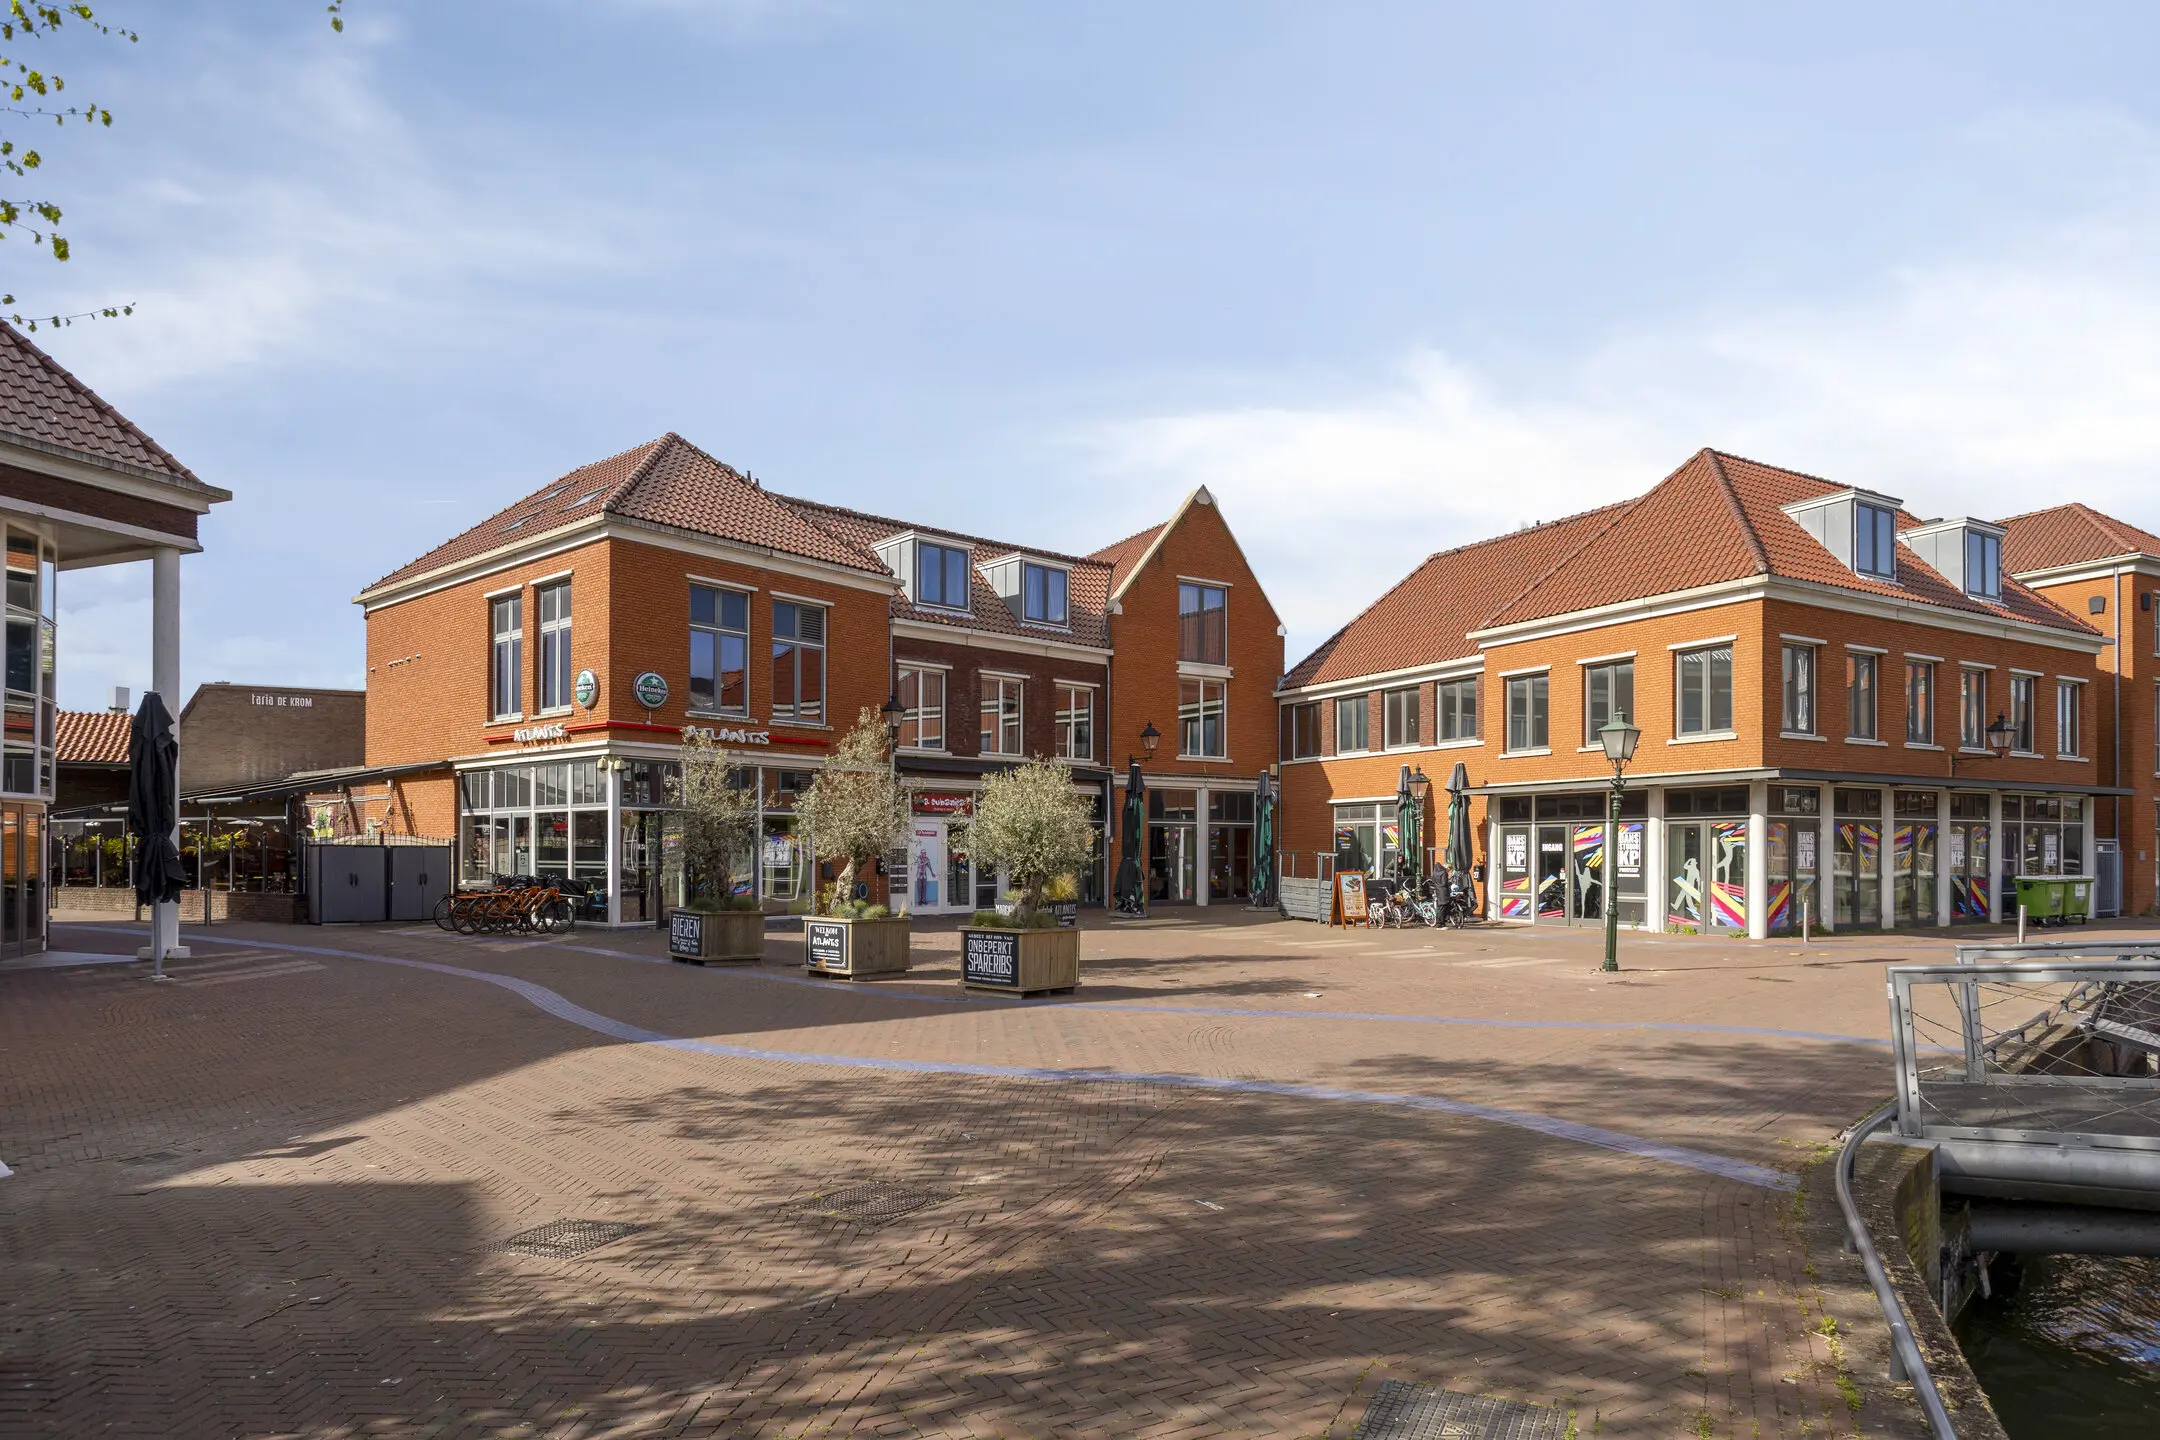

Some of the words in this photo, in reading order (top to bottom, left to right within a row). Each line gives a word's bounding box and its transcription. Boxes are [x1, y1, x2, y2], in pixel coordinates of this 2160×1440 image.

[277, 696, 287, 707] DE
[290, 696, 313, 707] KROM
[514, 723, 566, 742] ATLANTIS
[1542, 843, 1563, 852] INGANG
[1507, 852, 1525, 866] KP
[1619, 851, 1640, 865] KP
[1799, 852, 1814, 867] KP
[1952, 851, 1964, 865] KP
[2045, 851, 2057, 865] KP
[672, 917, 700, 939] BIEREN
[815, 926, 838, 935] WELKOM
[812, 936, 840, 947] ATLANTIS
[968, 939, 1013, 955] ONBEPERKT
[968, 952, 1012, 975] SPARERIBS
